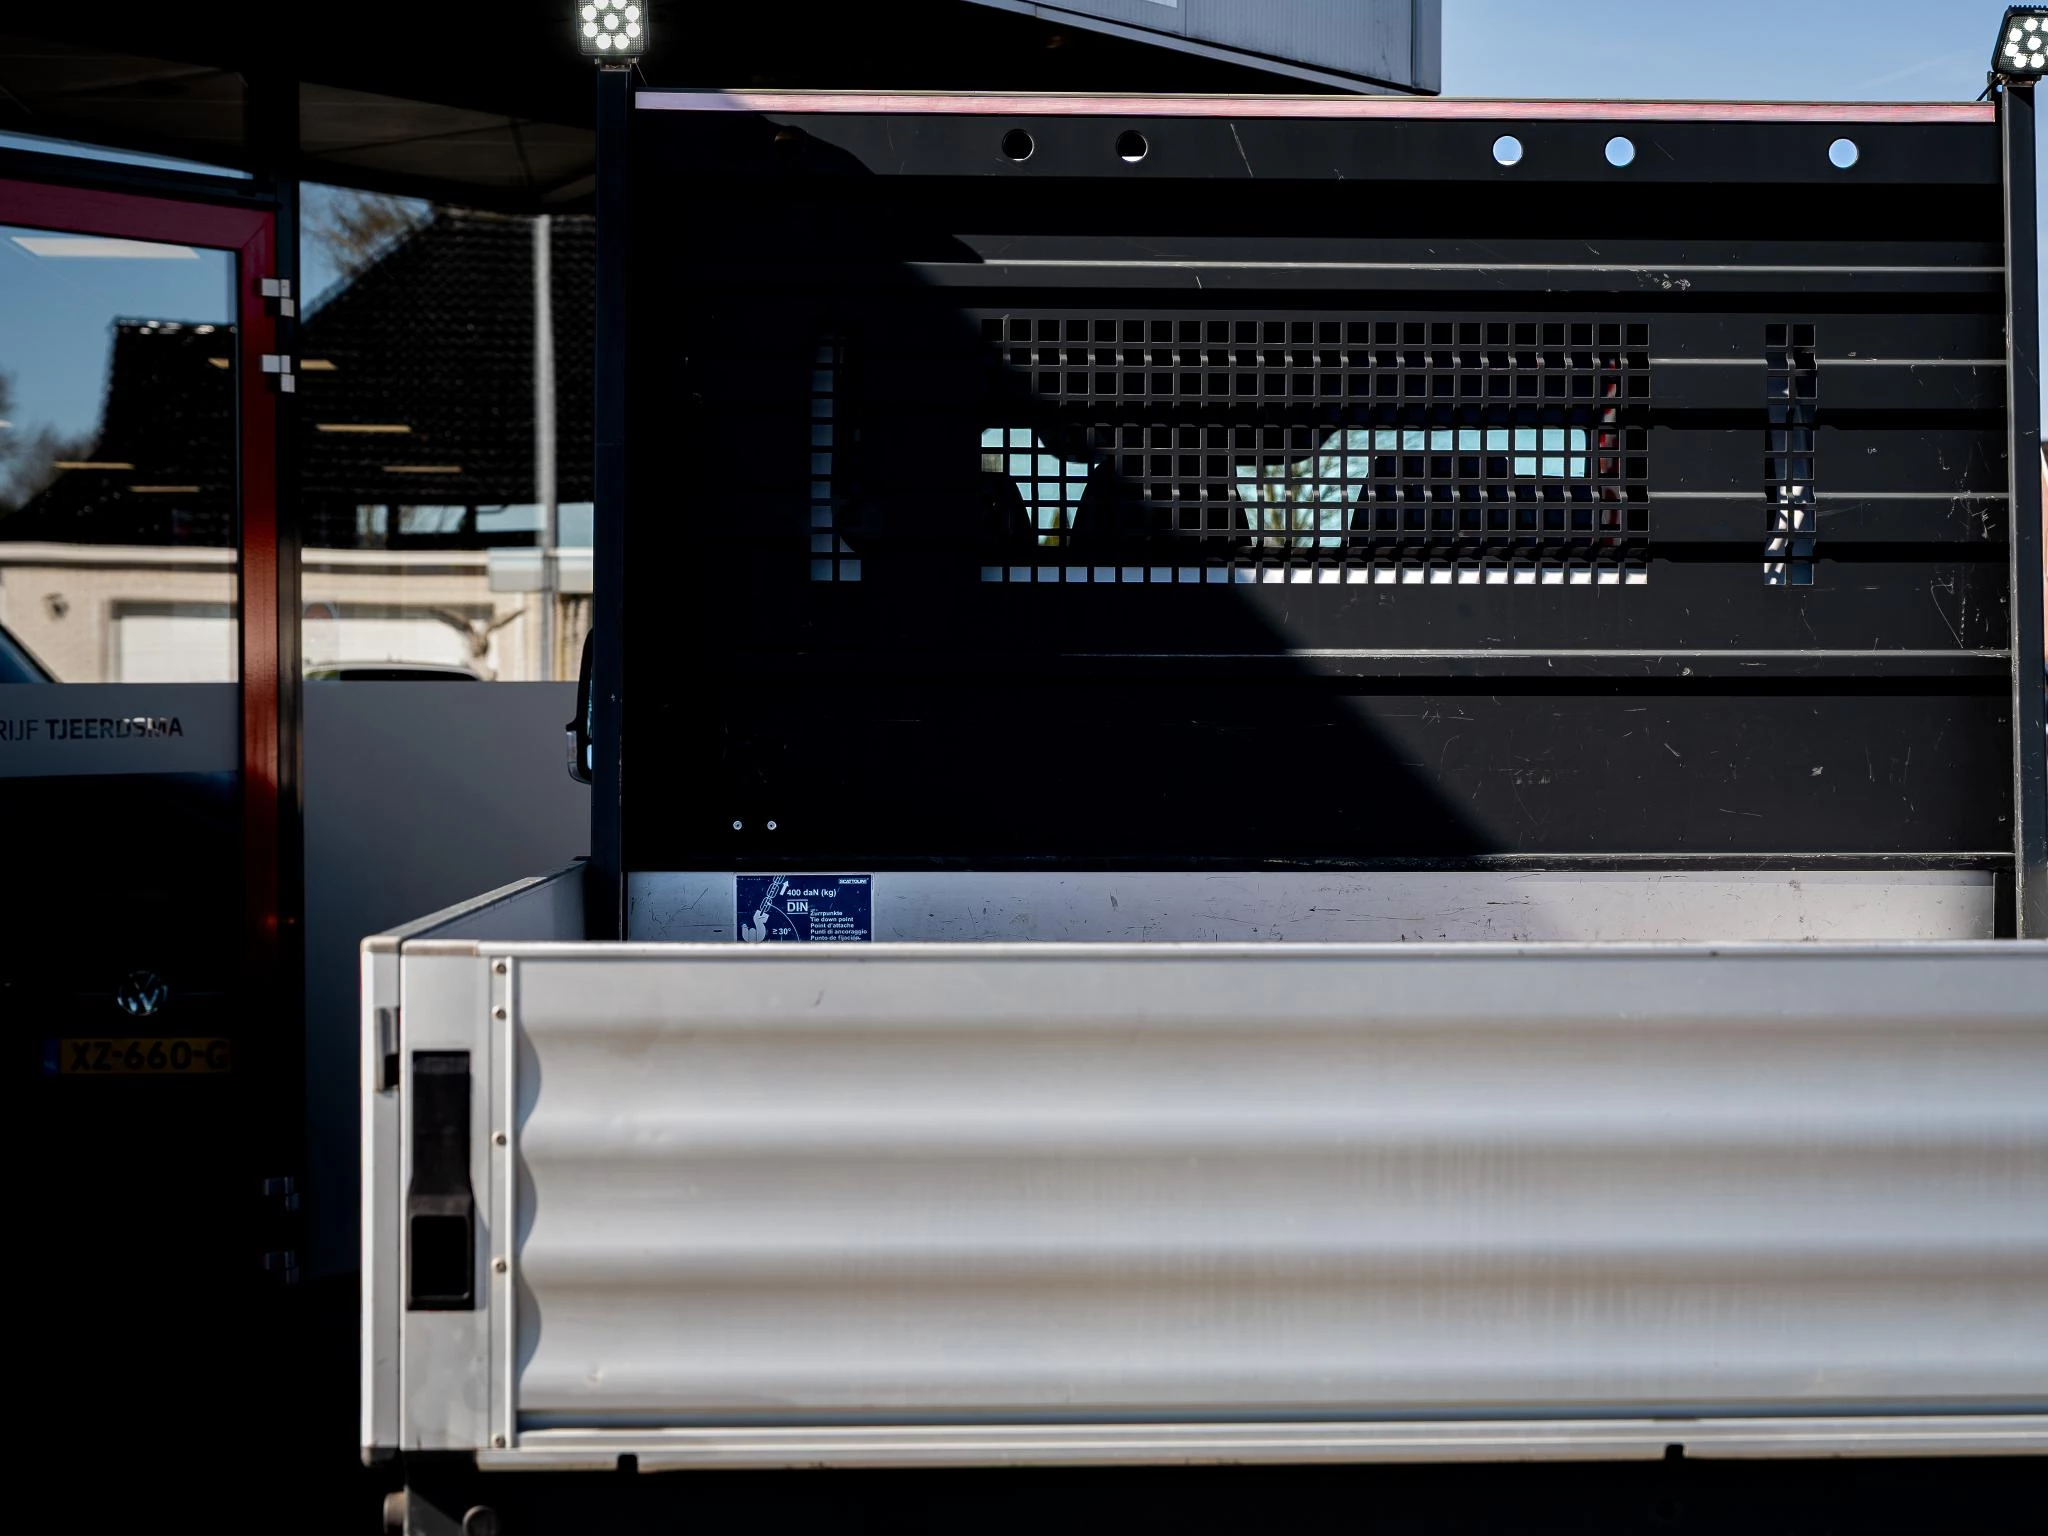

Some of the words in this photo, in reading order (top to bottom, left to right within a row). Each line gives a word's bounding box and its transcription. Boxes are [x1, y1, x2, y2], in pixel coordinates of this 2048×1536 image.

[45, 717, 183, 740] TJEERDSMA
[821, 889, 837, 897] (kg)
[787, 901, 808, 912] DIN
[71, 1041, 229, 1071] XZ-660-G
